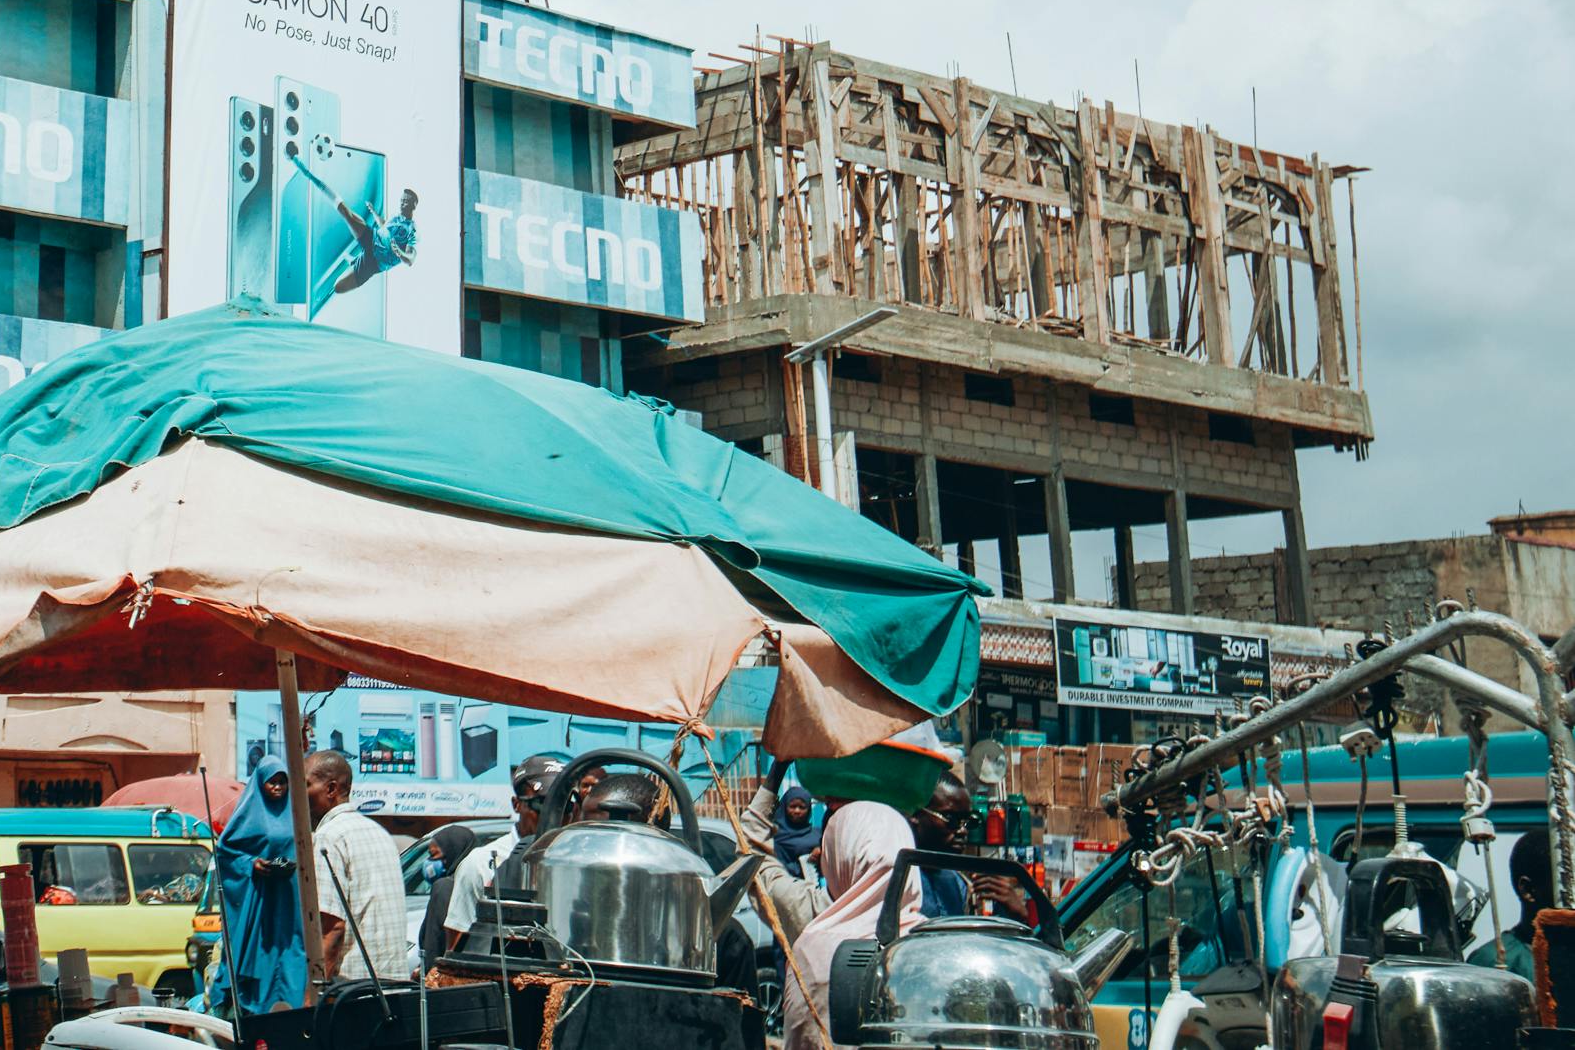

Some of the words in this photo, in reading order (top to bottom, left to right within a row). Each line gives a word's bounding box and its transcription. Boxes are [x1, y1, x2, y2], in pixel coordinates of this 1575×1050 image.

[244, 12, 266, 33] No
[274, 19, 317, 47] Pose,
[321, 31, 351, 52] Just
[355, 39, 397, 63] Snap!
[360, 3, 389, 33] 40
[475, 12, 652, 108] TECNO
[474, 202, 662, 292] TECNO
[1221, 636, 1263, 663] Royal
[1068, 690, 1105, 703] DURABLE
[1107, 693, 1154, 706] INVESTMENT
[1156, 696, 1194, 710] COMPANY
